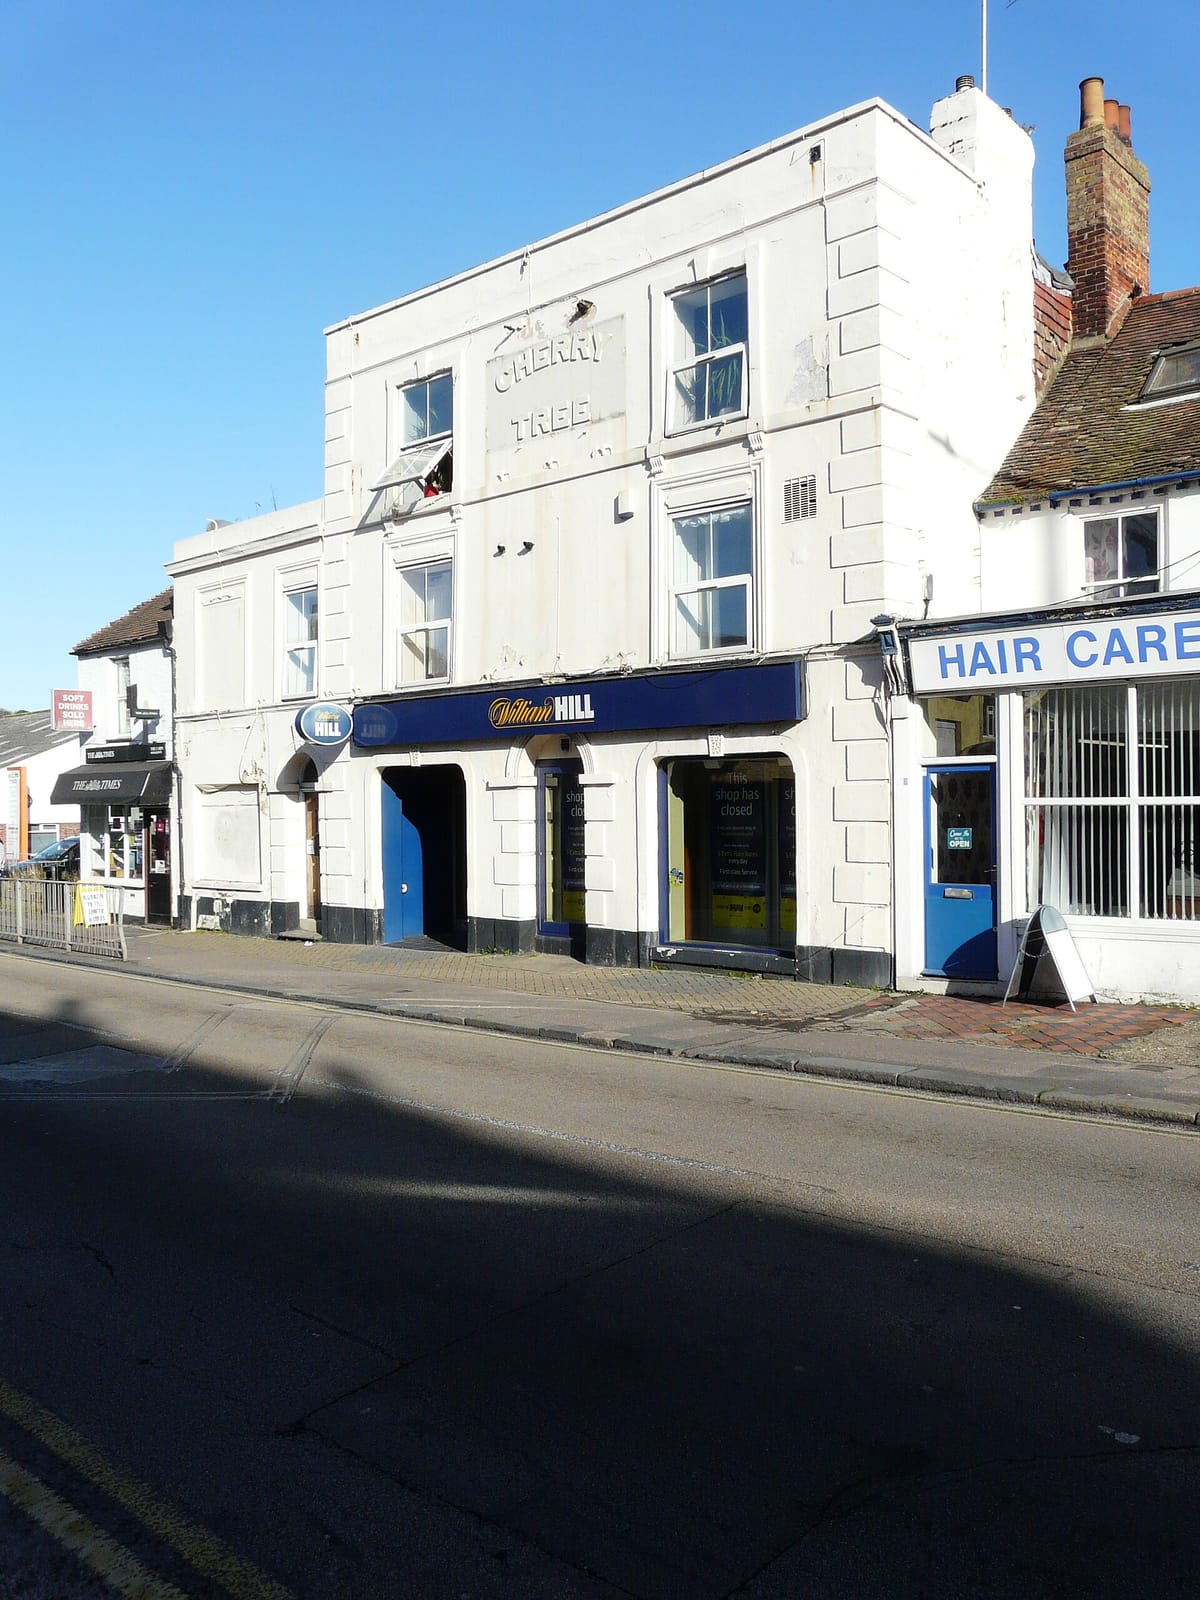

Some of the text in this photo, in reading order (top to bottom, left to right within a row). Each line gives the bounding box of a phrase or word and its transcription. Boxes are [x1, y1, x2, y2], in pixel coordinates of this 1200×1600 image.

[494, 331, 606, 393] CHERRY
[511, 396, 591, 441] TREE
[938, 619, 1200, 679] HAIR CARE
[62, 694, 85, 702] SOFT
[58, 702, 89, 711] DRINKS
[488, 693, 595, 727] William HILL
[62, 711, 85, 719] SOLD
[314, 721, 342, 737] HILL
[72, 779, 121, 791] THE TIMES
[728, 772, 748, 785] This
[715, 787, 760, 803] shop has
[720, 804, 753, 817] closed
[949, 840, 970, 848] OPEN
